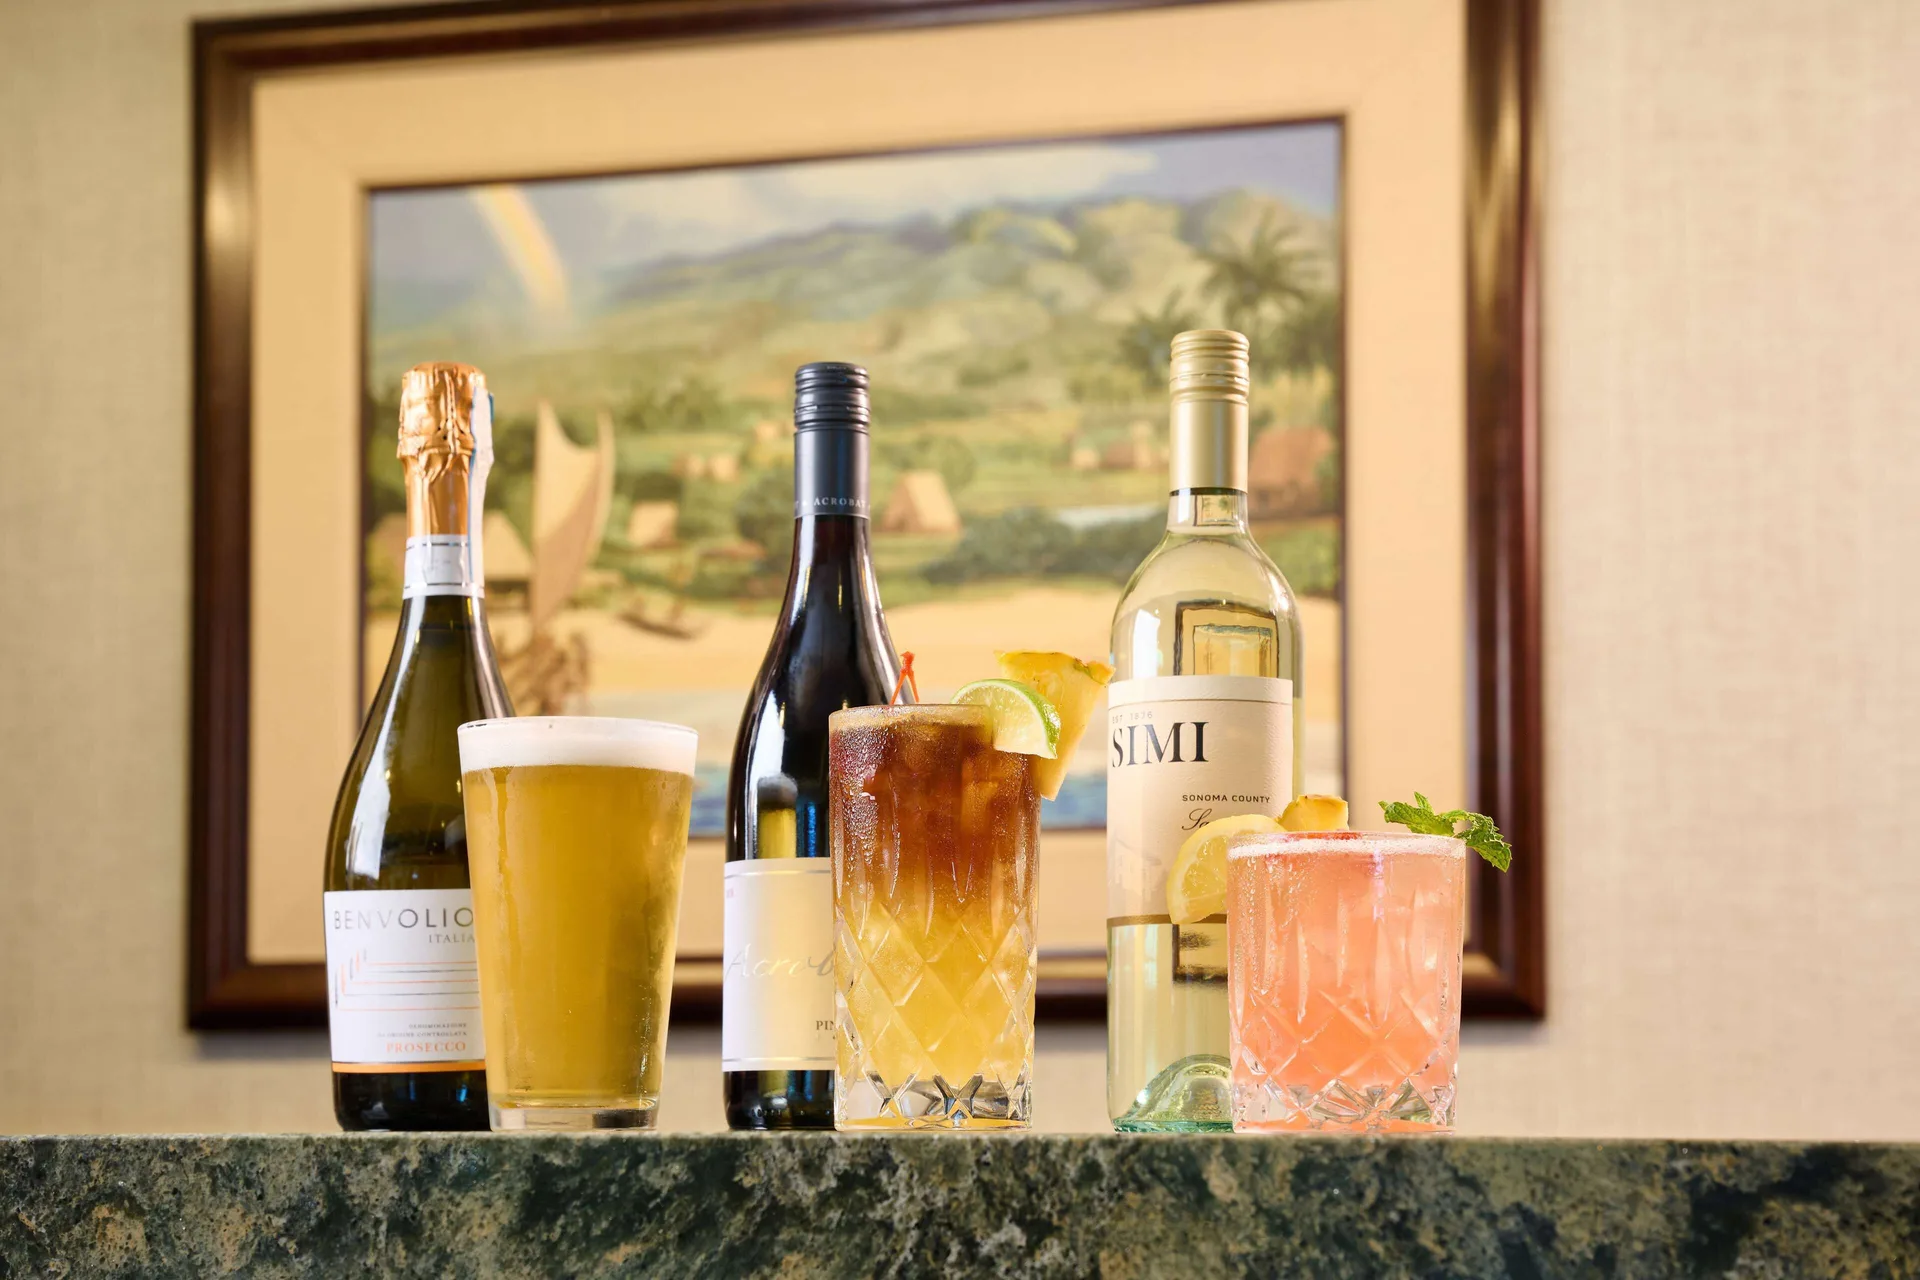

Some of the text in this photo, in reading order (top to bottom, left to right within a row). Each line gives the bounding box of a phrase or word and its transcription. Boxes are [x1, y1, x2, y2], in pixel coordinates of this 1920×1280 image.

[813, 496, 866, 508] ACROBAT
[1130, 711, 1153, 721] 1876
[1111, 721, 1209, 768] SIMI
[1182, 794, 1270, 803] SONOMA COUNTY
[333, 907, 474, 929] BENVOLIO
[428, 932, 475, 944] ITALIA
[386, 1041, 467, 1053] PROSECCO
